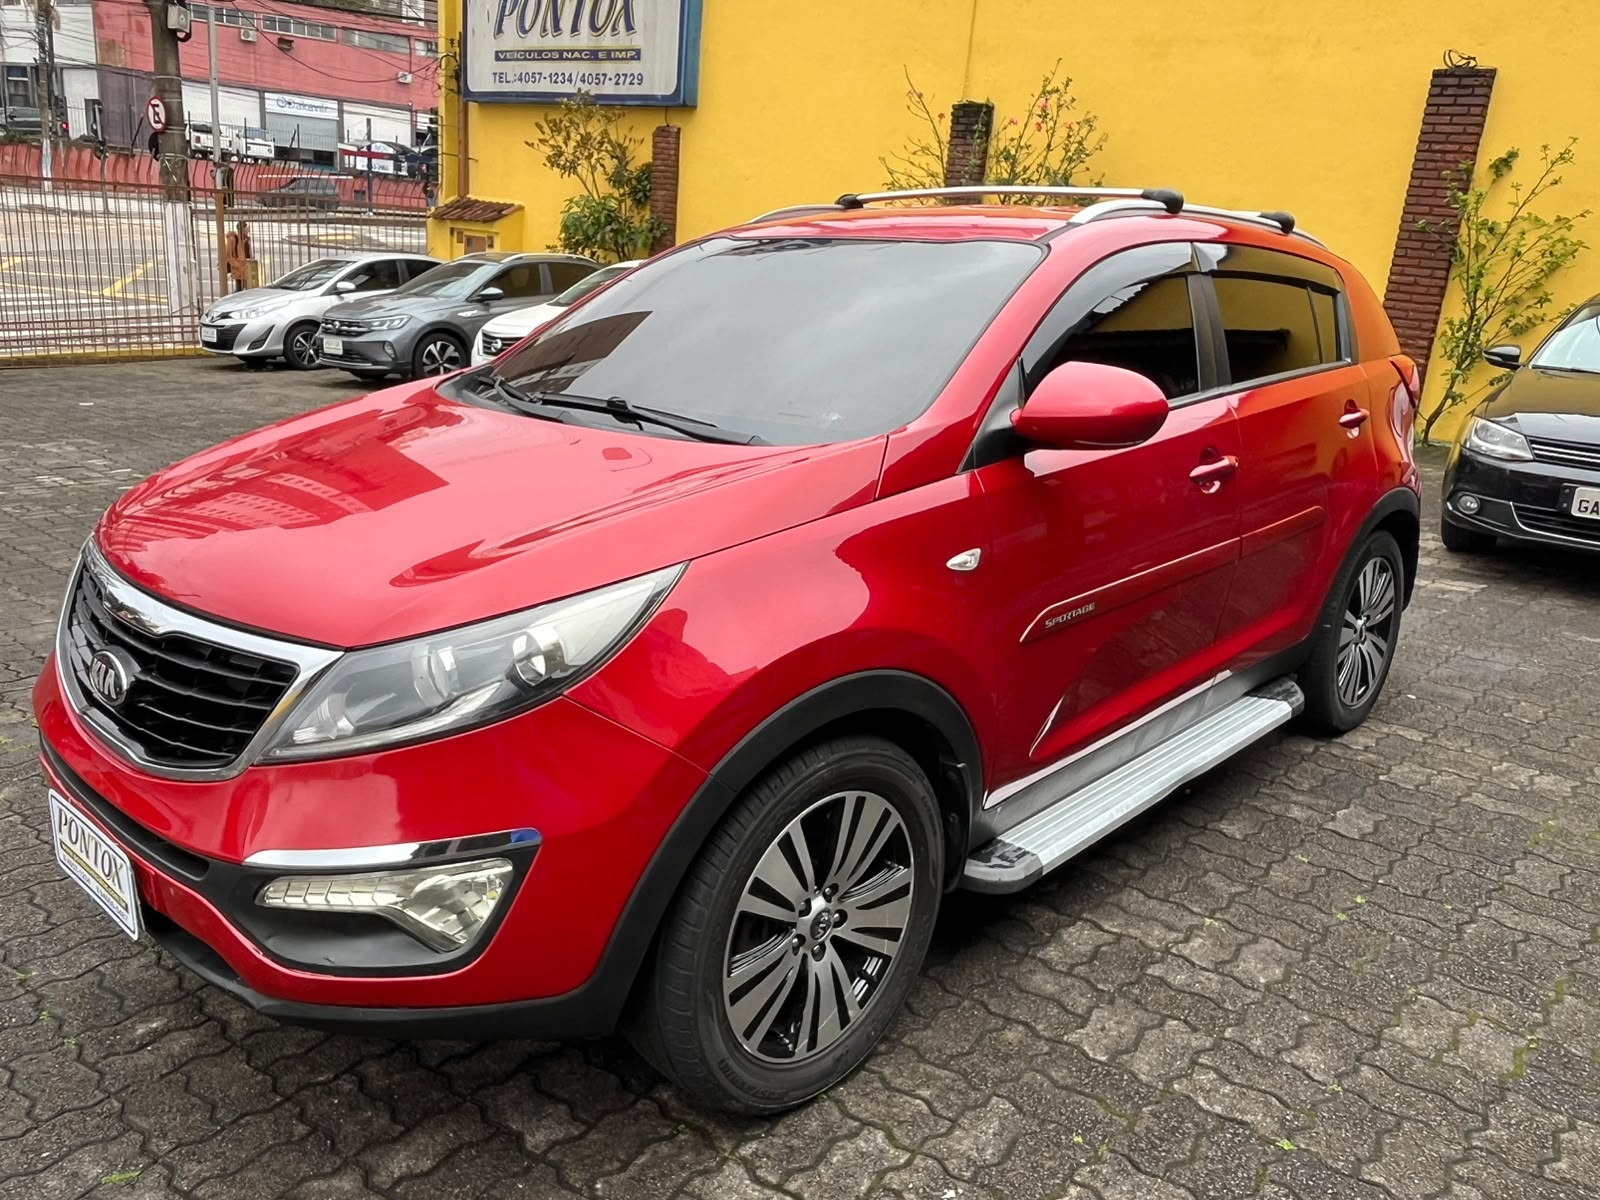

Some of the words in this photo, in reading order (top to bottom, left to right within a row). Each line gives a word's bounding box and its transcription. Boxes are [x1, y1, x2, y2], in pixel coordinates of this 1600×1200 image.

[563, 51, 594, 59] NAC.
[598, 51, 607, 59] E
[611, 51, 638, 59] IMP.
[1045, 602, 1096, 628] SPORTAGE
[91, 657, 116, 699] KIA
[57, 806, 125, 894] PONTOX
